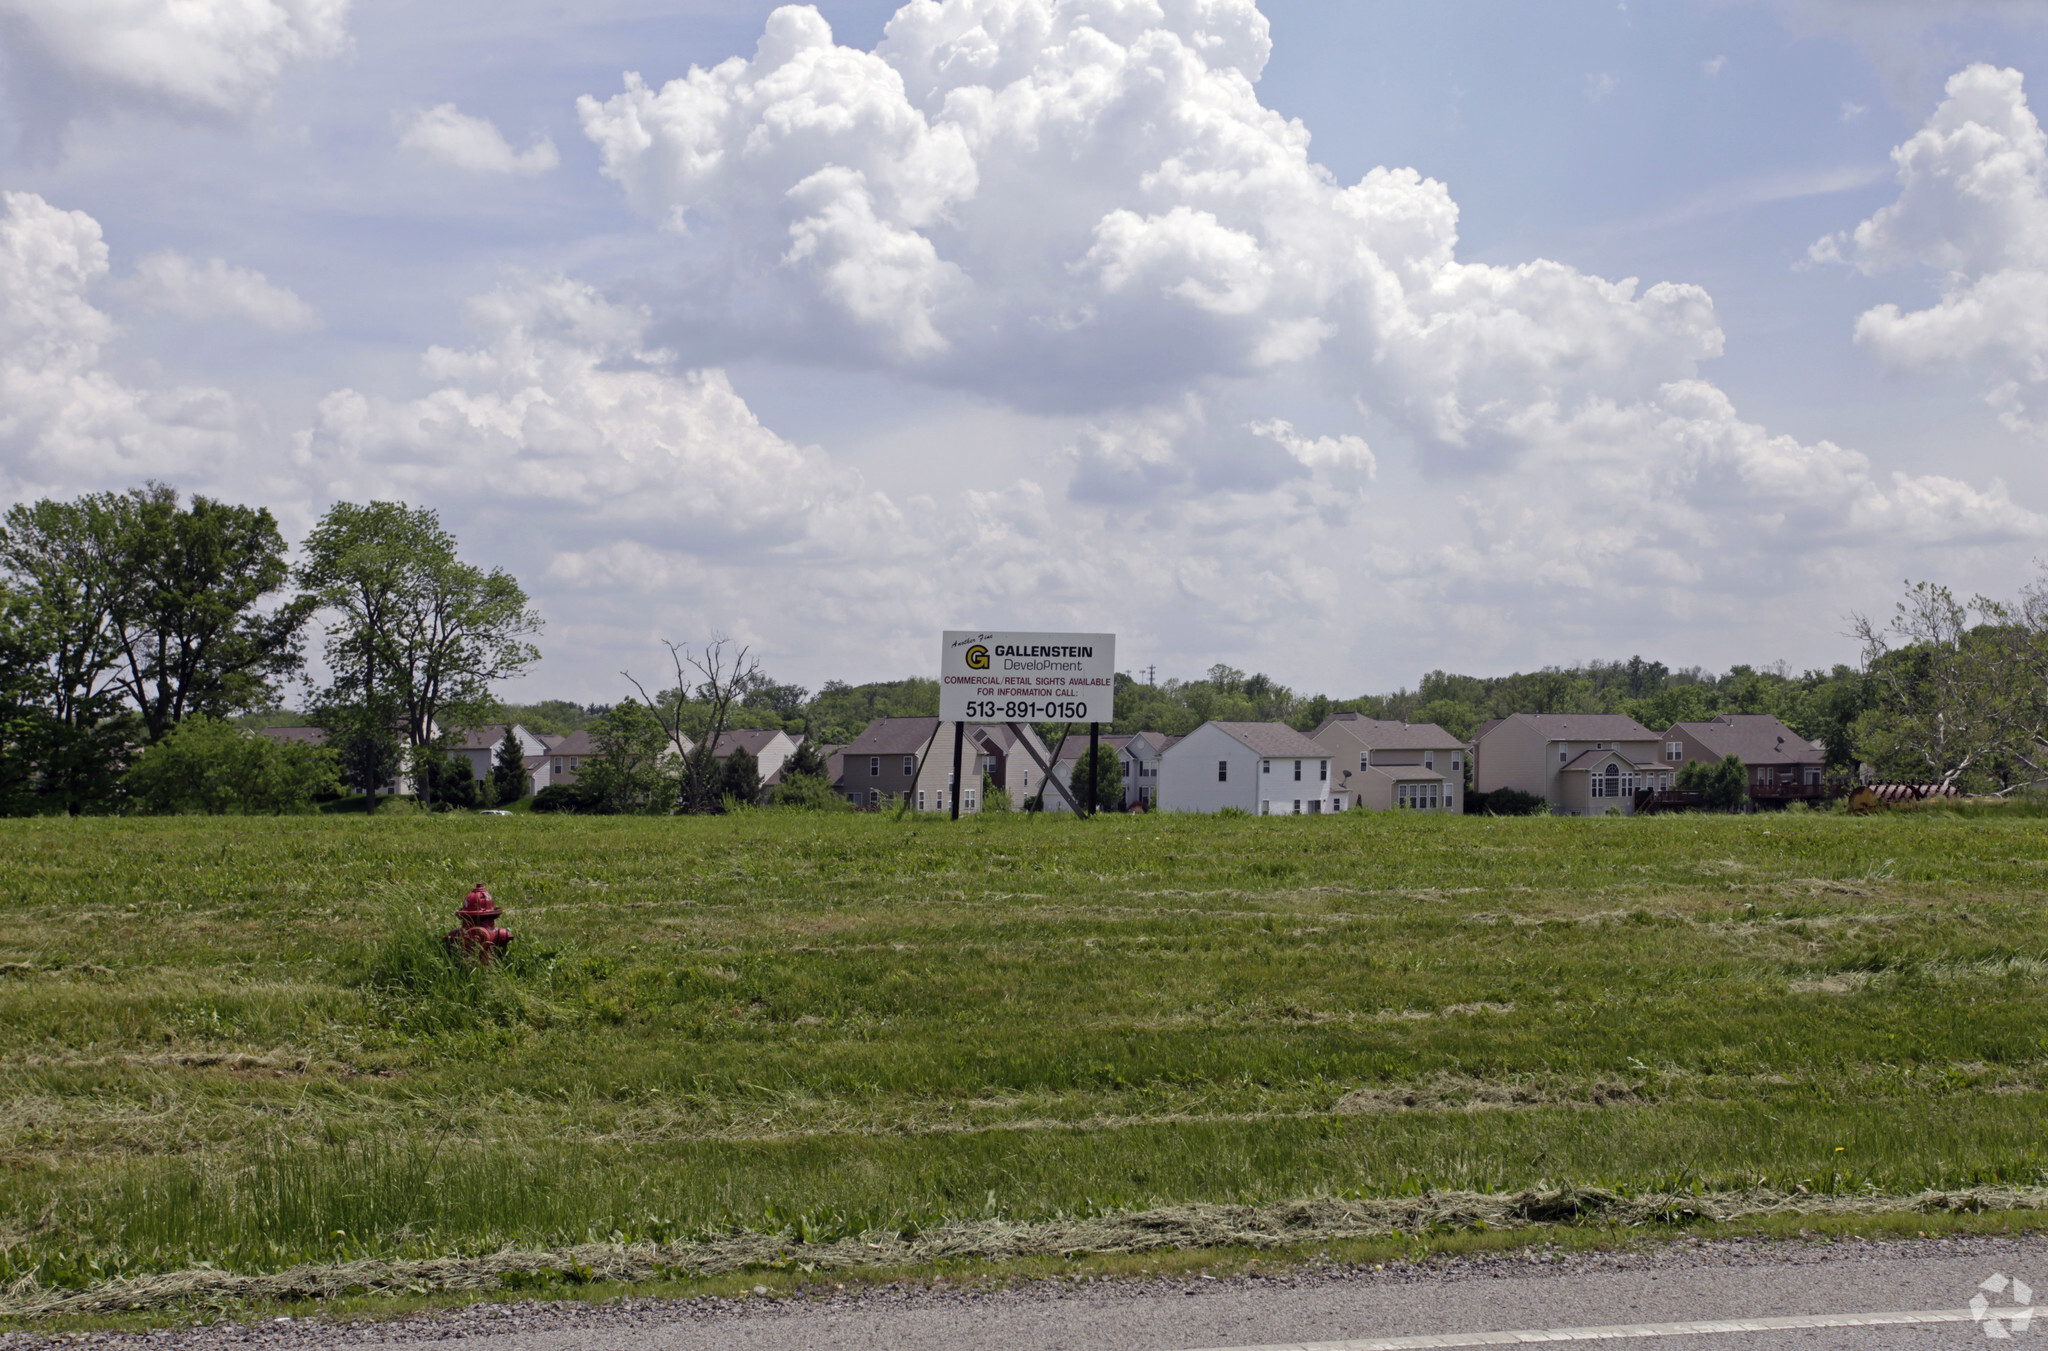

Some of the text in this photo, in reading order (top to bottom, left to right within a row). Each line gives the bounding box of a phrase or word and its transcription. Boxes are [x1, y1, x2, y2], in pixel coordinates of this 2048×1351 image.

[951, 634, 993, 648] Another Fine
[995, 645, 1093, 658] GALLENSTEIN
[944, 676, 1111, 686] COMMERCIAL/RETAIL SIGHTS AVAILABLE
[977, 687, 1078, 697] FOR INFORMATION CALL:
[966, 701, 1087, 718] 513-891-0150
